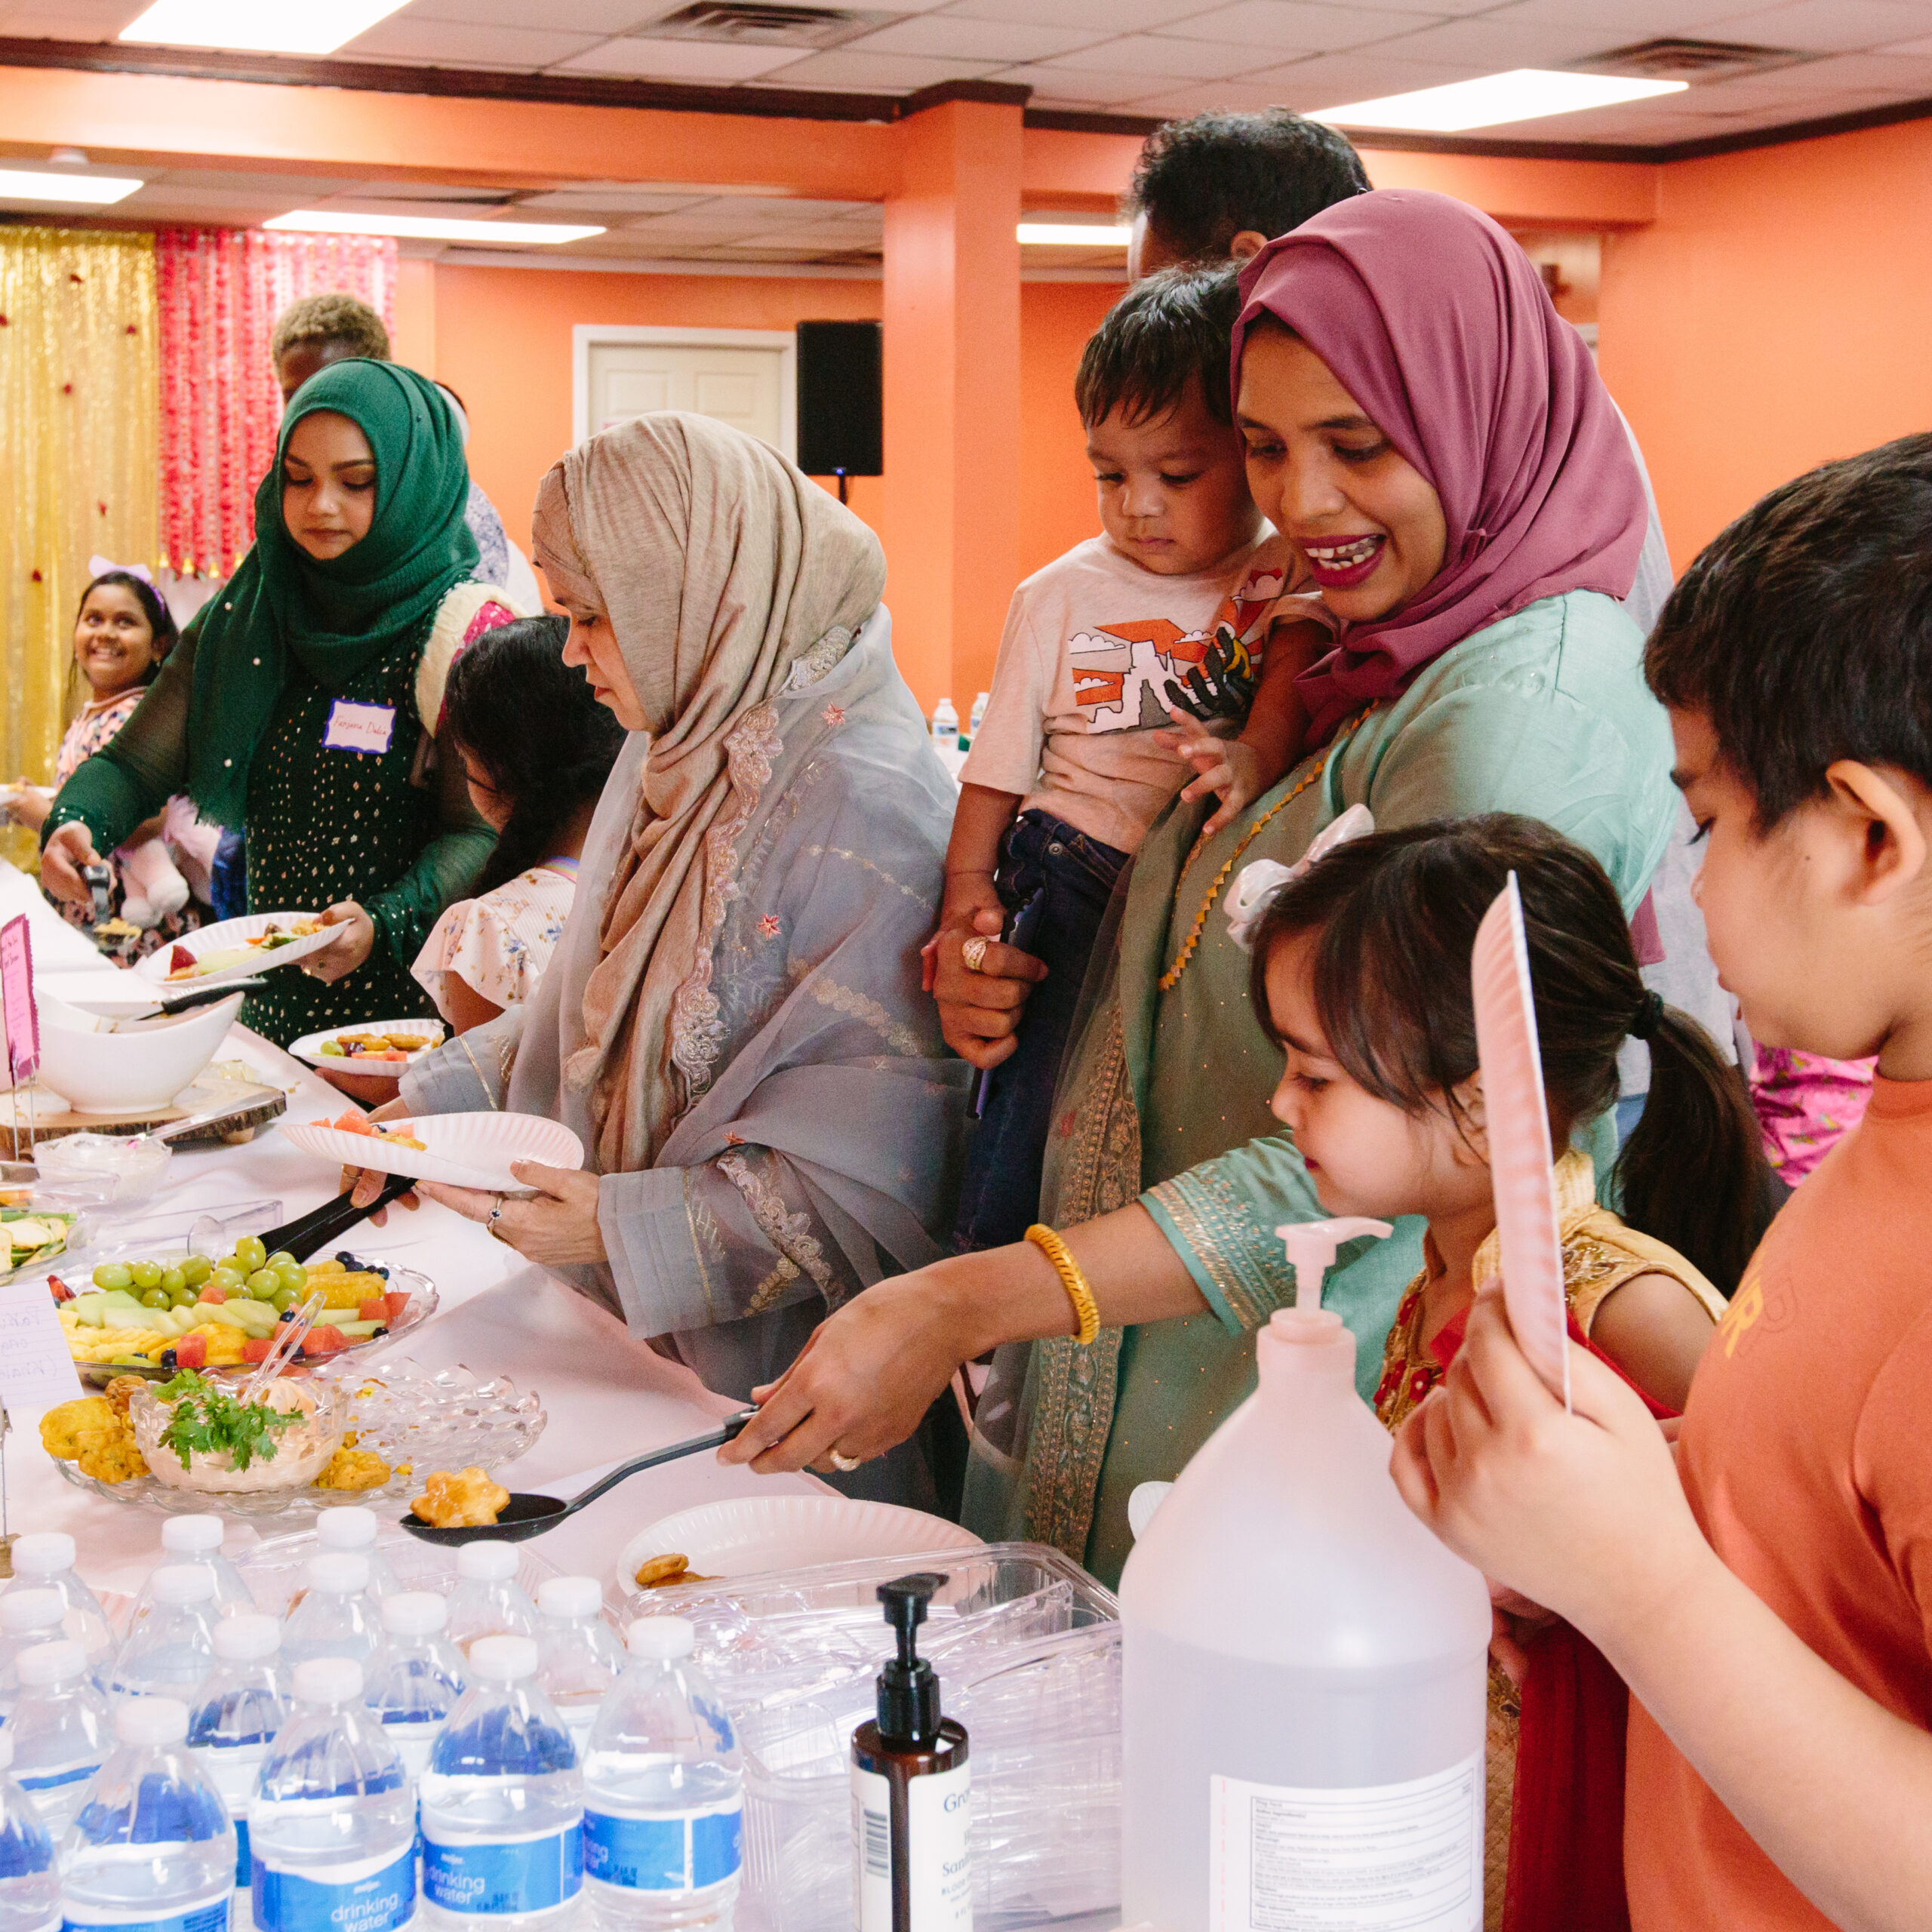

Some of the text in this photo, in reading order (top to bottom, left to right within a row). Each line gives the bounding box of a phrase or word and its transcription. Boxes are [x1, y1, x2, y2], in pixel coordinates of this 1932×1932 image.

[434, 1884, 473, 1905] water
[330, 1892, 398, 1922] drinking
[343, 1911, 389, 1932] water
